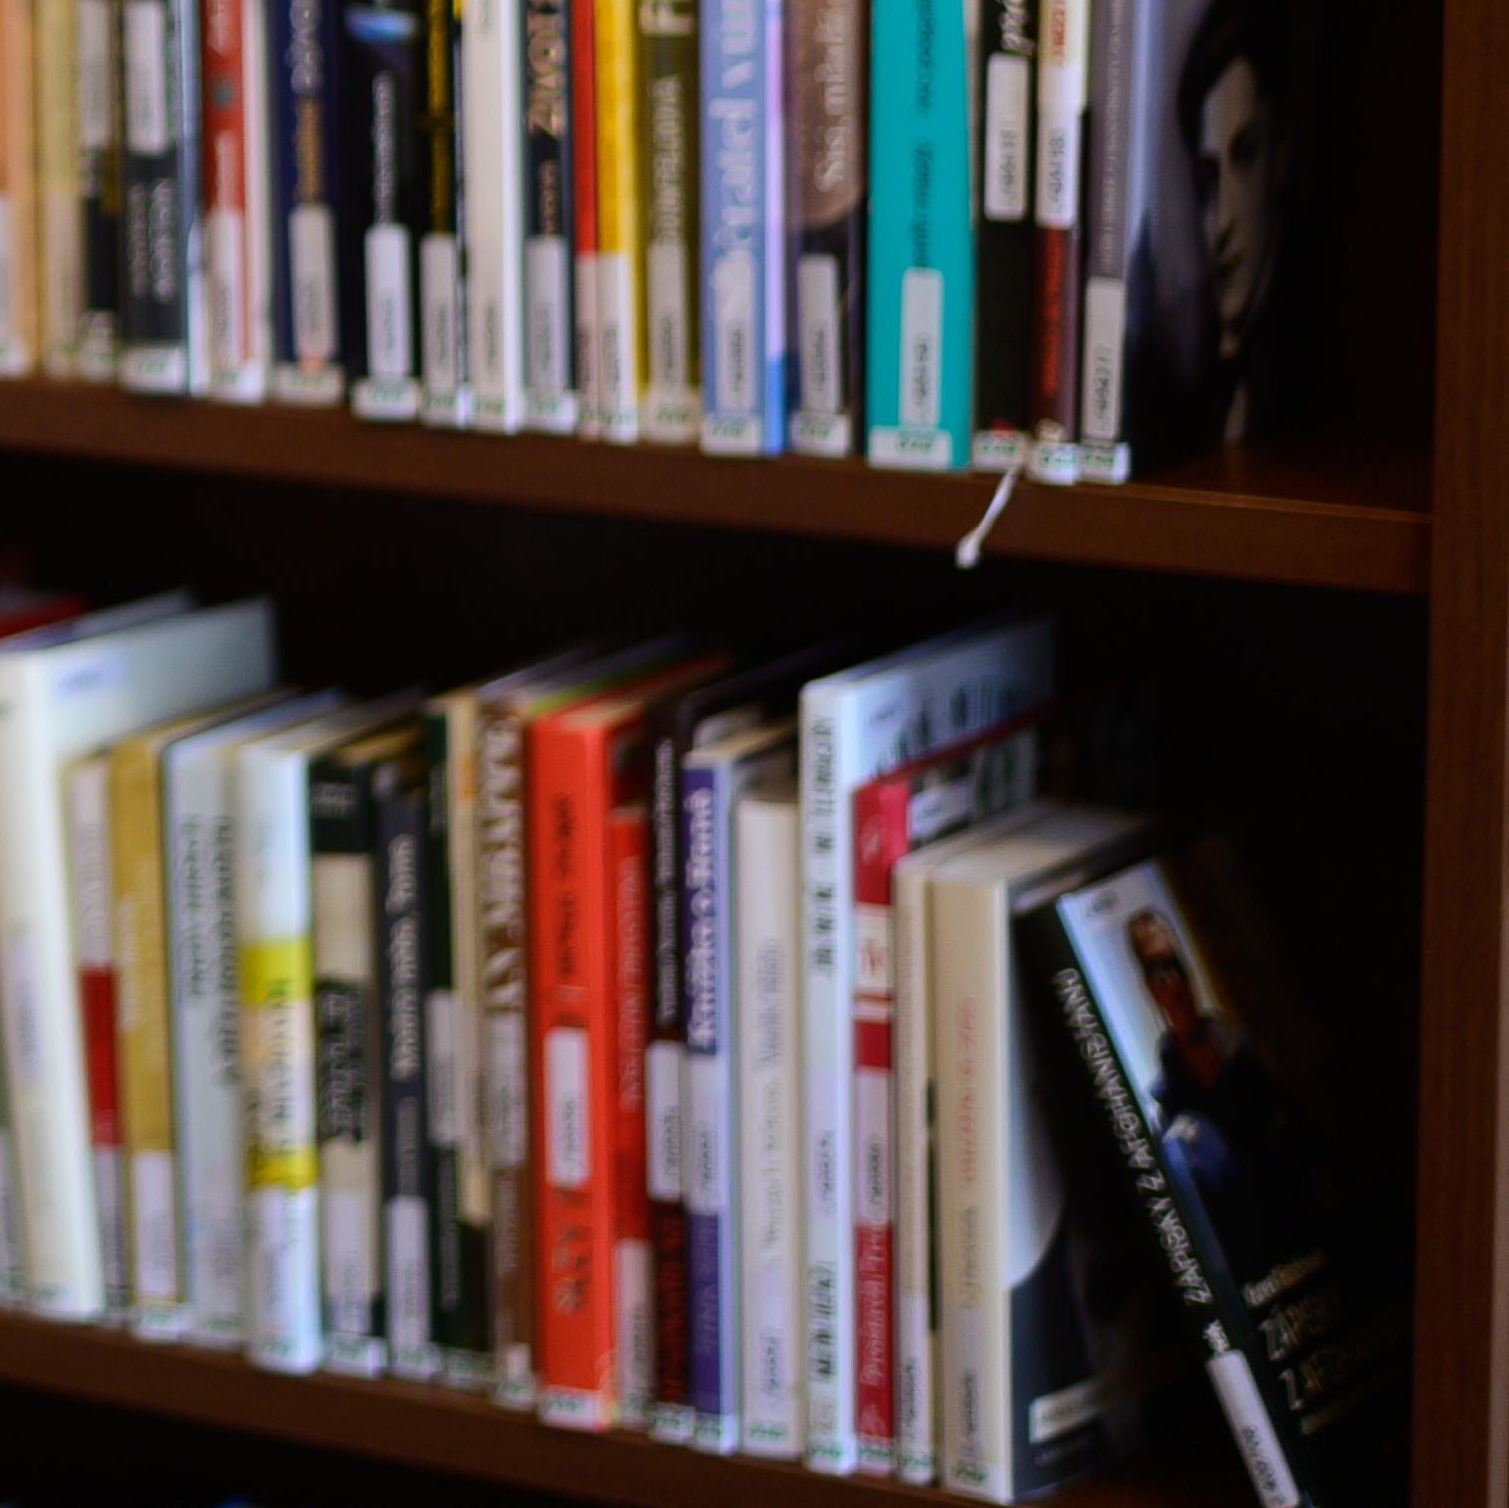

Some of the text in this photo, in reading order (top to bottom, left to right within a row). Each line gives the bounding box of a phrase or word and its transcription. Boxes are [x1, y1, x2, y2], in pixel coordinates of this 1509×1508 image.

[1050, 966, 1215, 1310] ZÁPISKY Z AFGHÁNISTÁNU
